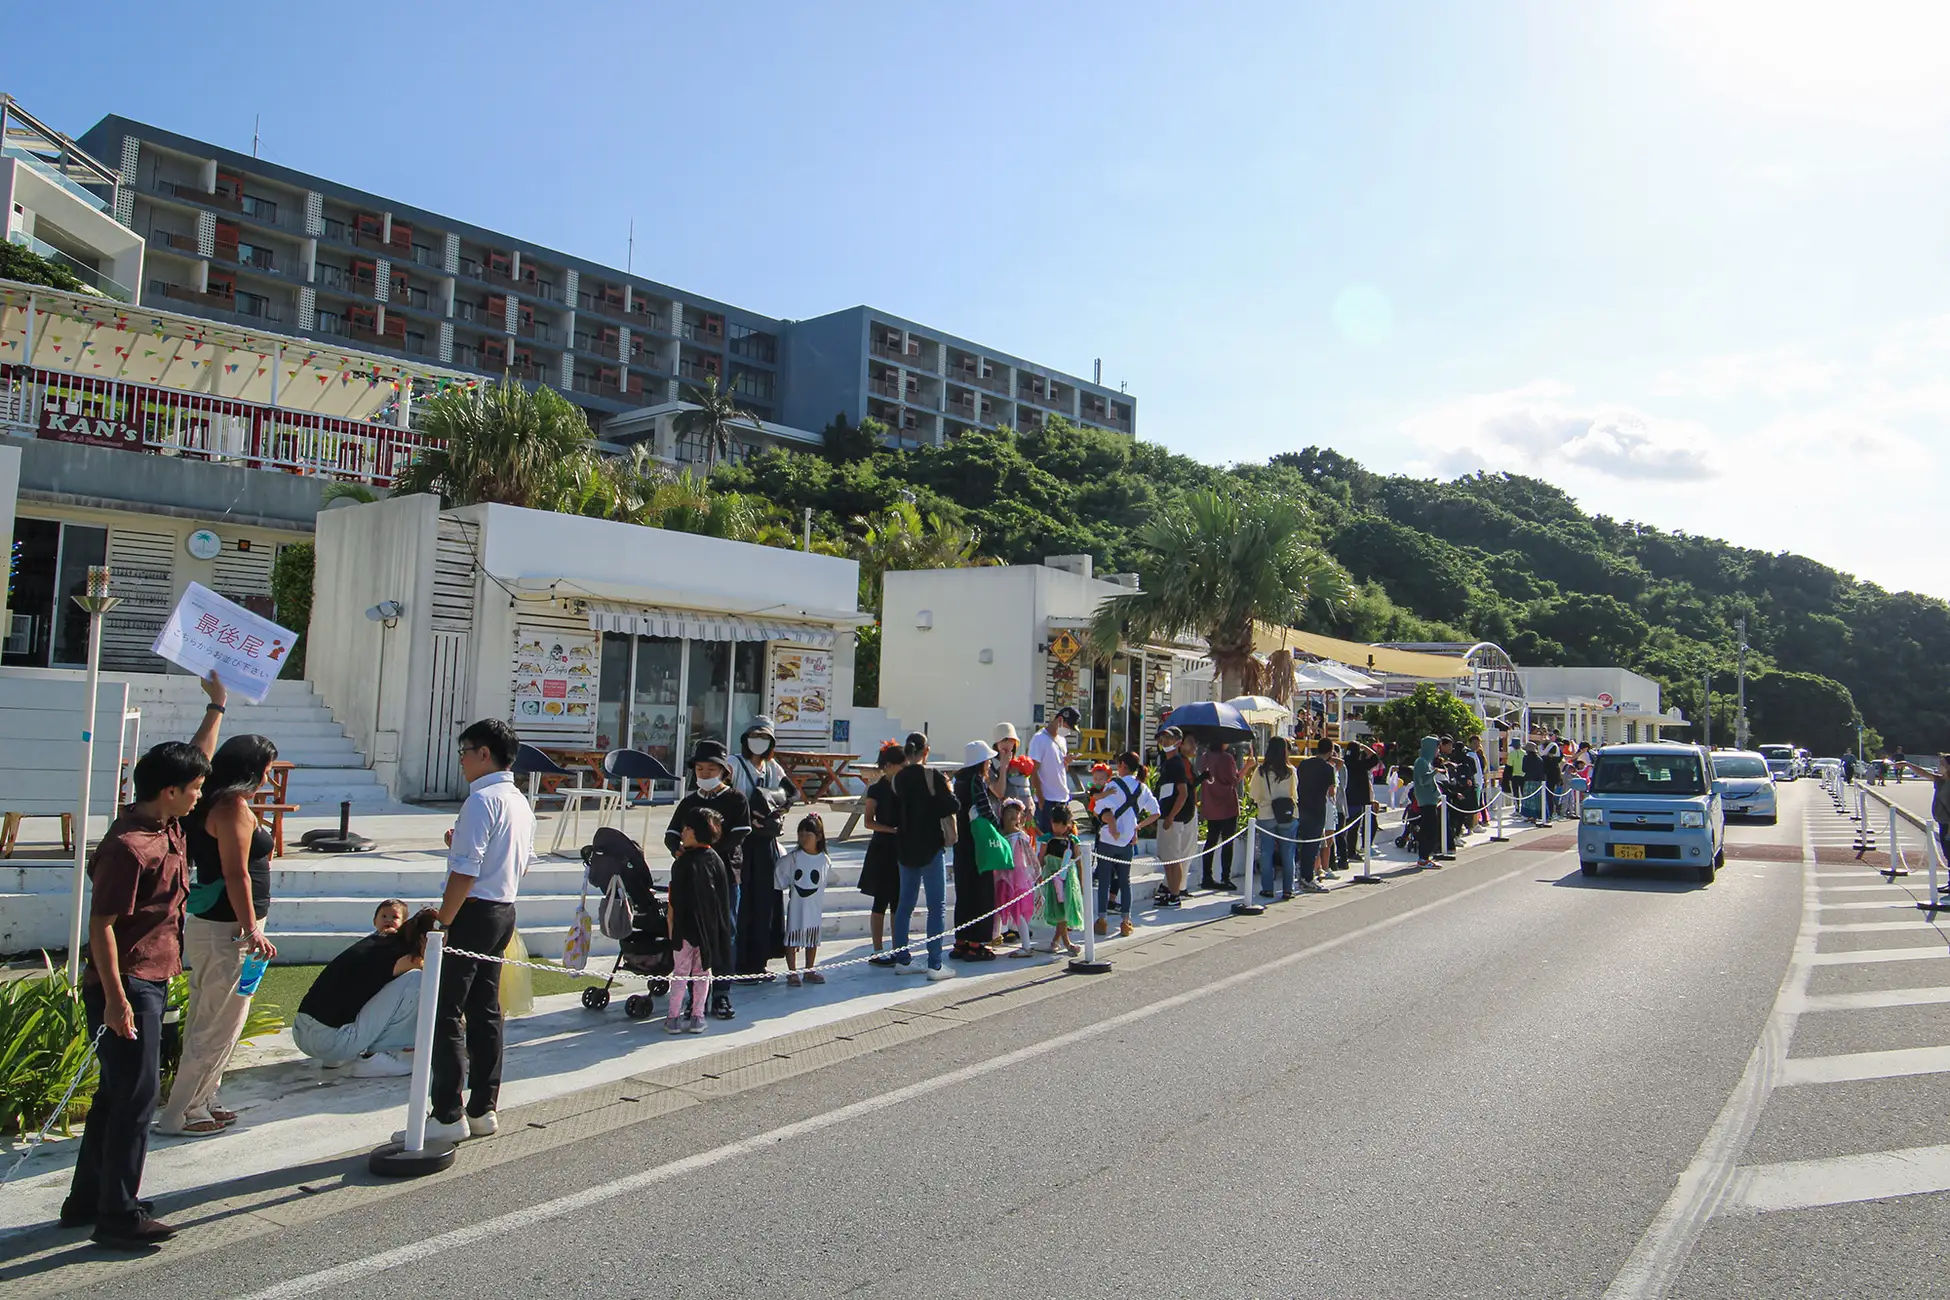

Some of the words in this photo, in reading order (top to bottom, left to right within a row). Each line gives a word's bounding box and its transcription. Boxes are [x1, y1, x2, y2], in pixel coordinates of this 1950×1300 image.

[46, 413, 138, 441] KAN's
[173, 629, 269, 678] こちらからお並び下さい
[194, 612, 265, 659] 最後尾
